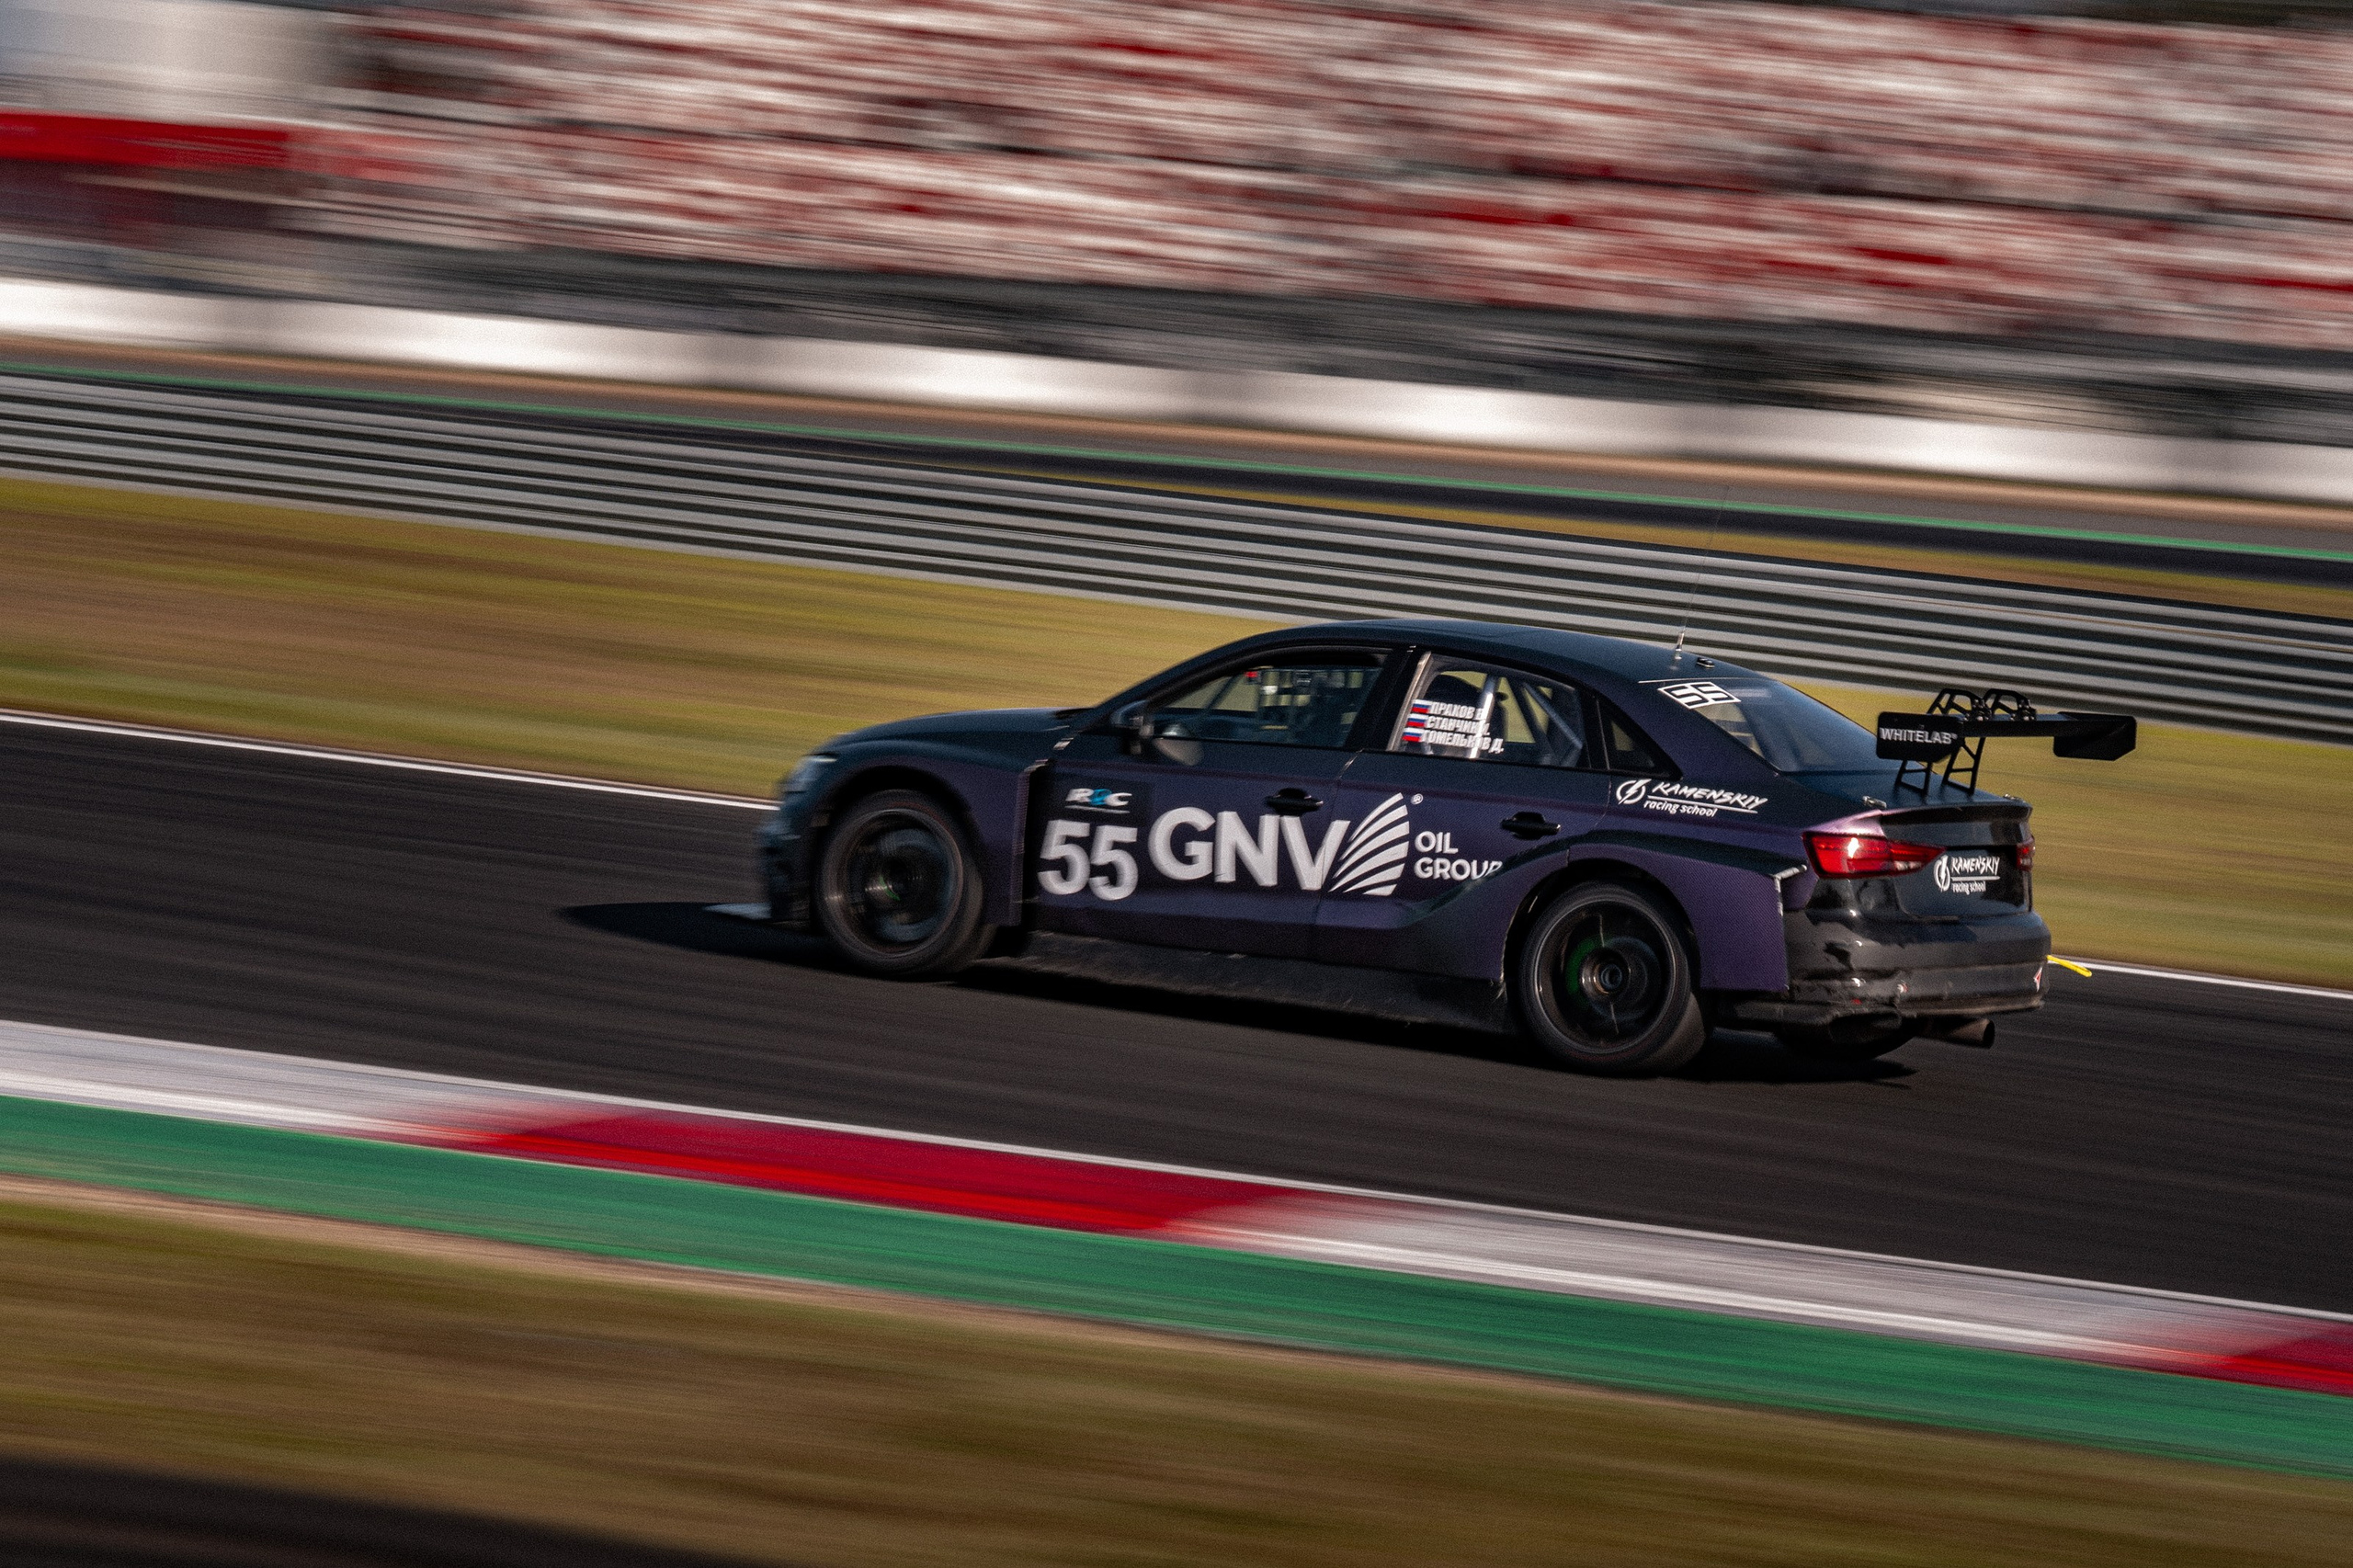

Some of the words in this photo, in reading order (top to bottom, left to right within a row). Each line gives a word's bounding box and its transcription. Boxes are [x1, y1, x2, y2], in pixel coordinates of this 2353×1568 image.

[1879, 727, 1952, 745] WHITELAB
[1651, 781, 1768, 810] KAMENSKIY
[1643, 799, 1679, 814] racing
[1680, 801, 1718, 818] school
[1147, 806, 1350, 892] GNV
[1415, 831, 1459, 854] OIL
[1038, 819, 1139, 901] 55
[1414, 857, 1503, 881] GROUP
[1950, 856, 2000, 875] KAMENSKIY
[1952, 881, 1970, 895] racing
[1970, 881, 1986, 892] school
